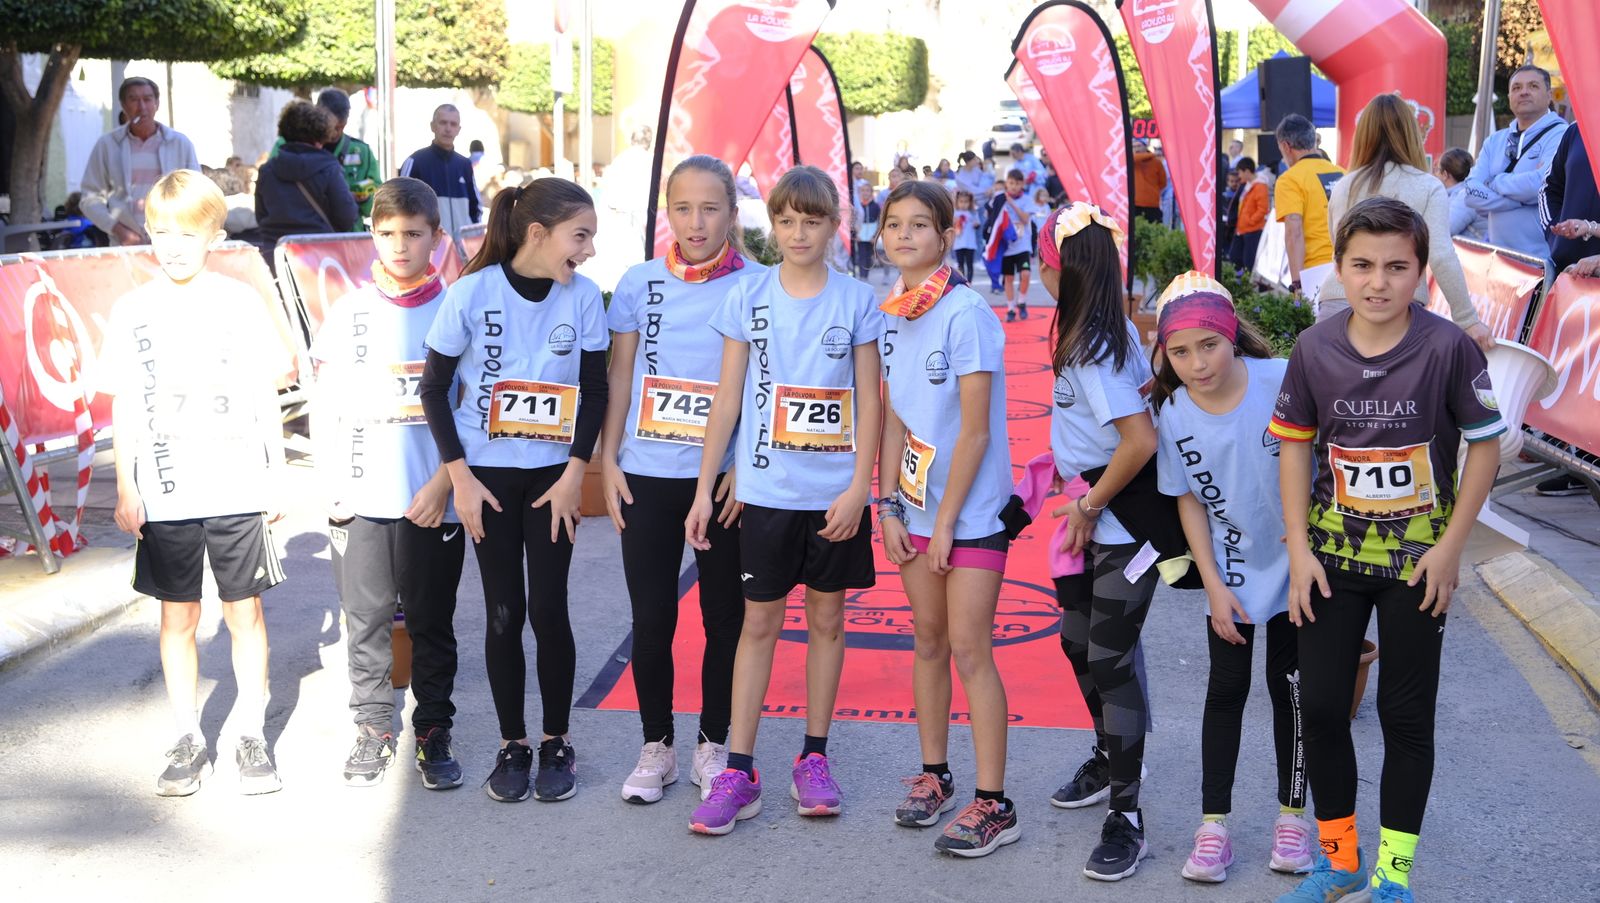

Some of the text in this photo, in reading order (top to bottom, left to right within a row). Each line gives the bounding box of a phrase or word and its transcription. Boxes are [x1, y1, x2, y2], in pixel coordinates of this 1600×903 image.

[647, 280, 665, 305] LA
[484, 310, 503, 337] LA
[751, 305, 769, 331] LA
[133, 324, 152, 353] LA
[502, 393, 557, 416] 711
[656, 391, 712, 417] 742
[789, 401, 841, 424] 726
[1333, 399, 1418, 416] CUELLAR
[1345, 421, 1407, 429] STONE 1958
[1175, 435, 1202, 467] LA
[1343, 465, 1412, 489] 710
